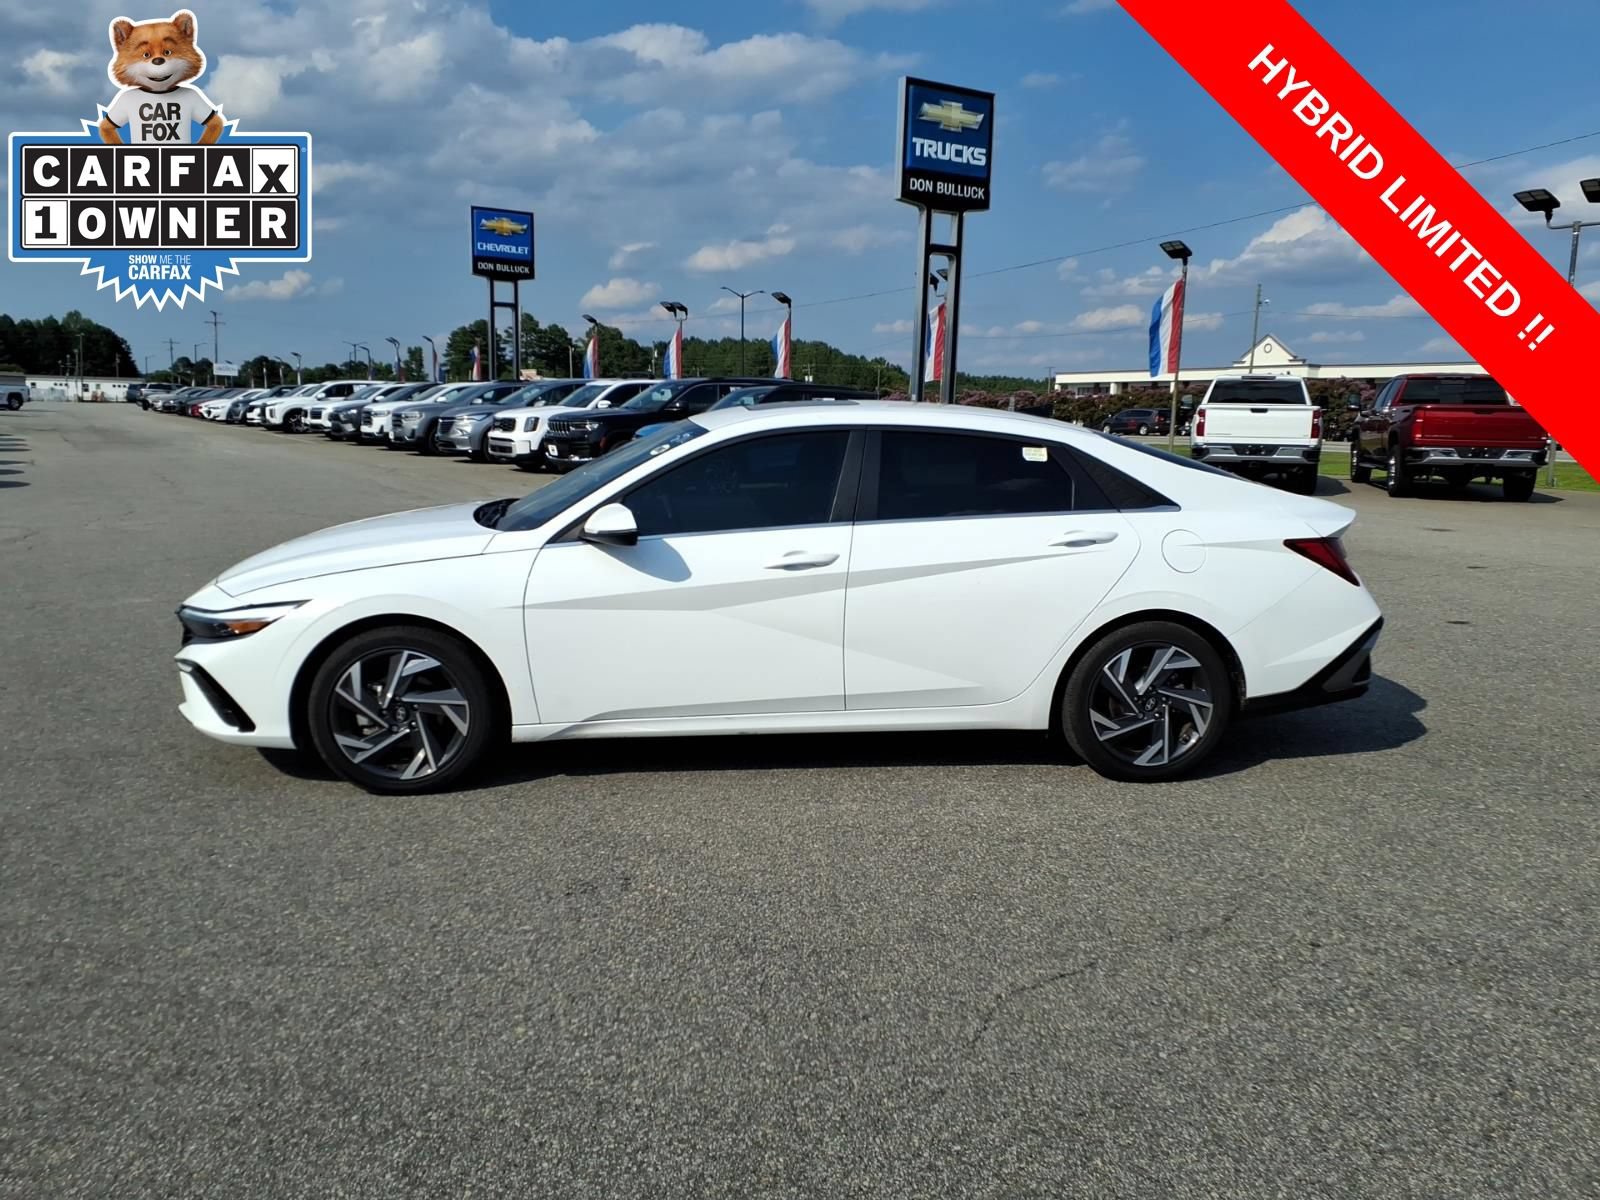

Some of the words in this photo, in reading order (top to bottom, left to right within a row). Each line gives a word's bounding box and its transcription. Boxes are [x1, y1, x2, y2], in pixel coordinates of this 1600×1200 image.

[912, 137, 986, 166] TRUCKS
[910, 178, 933, 193] DON
[937, 182, 985, 200] BULLUCK
[477, 242, 528, 255] CHEVROLET
[477, 261, 494, 271] DON
[496, 263, 530, 274] BULLUCK
